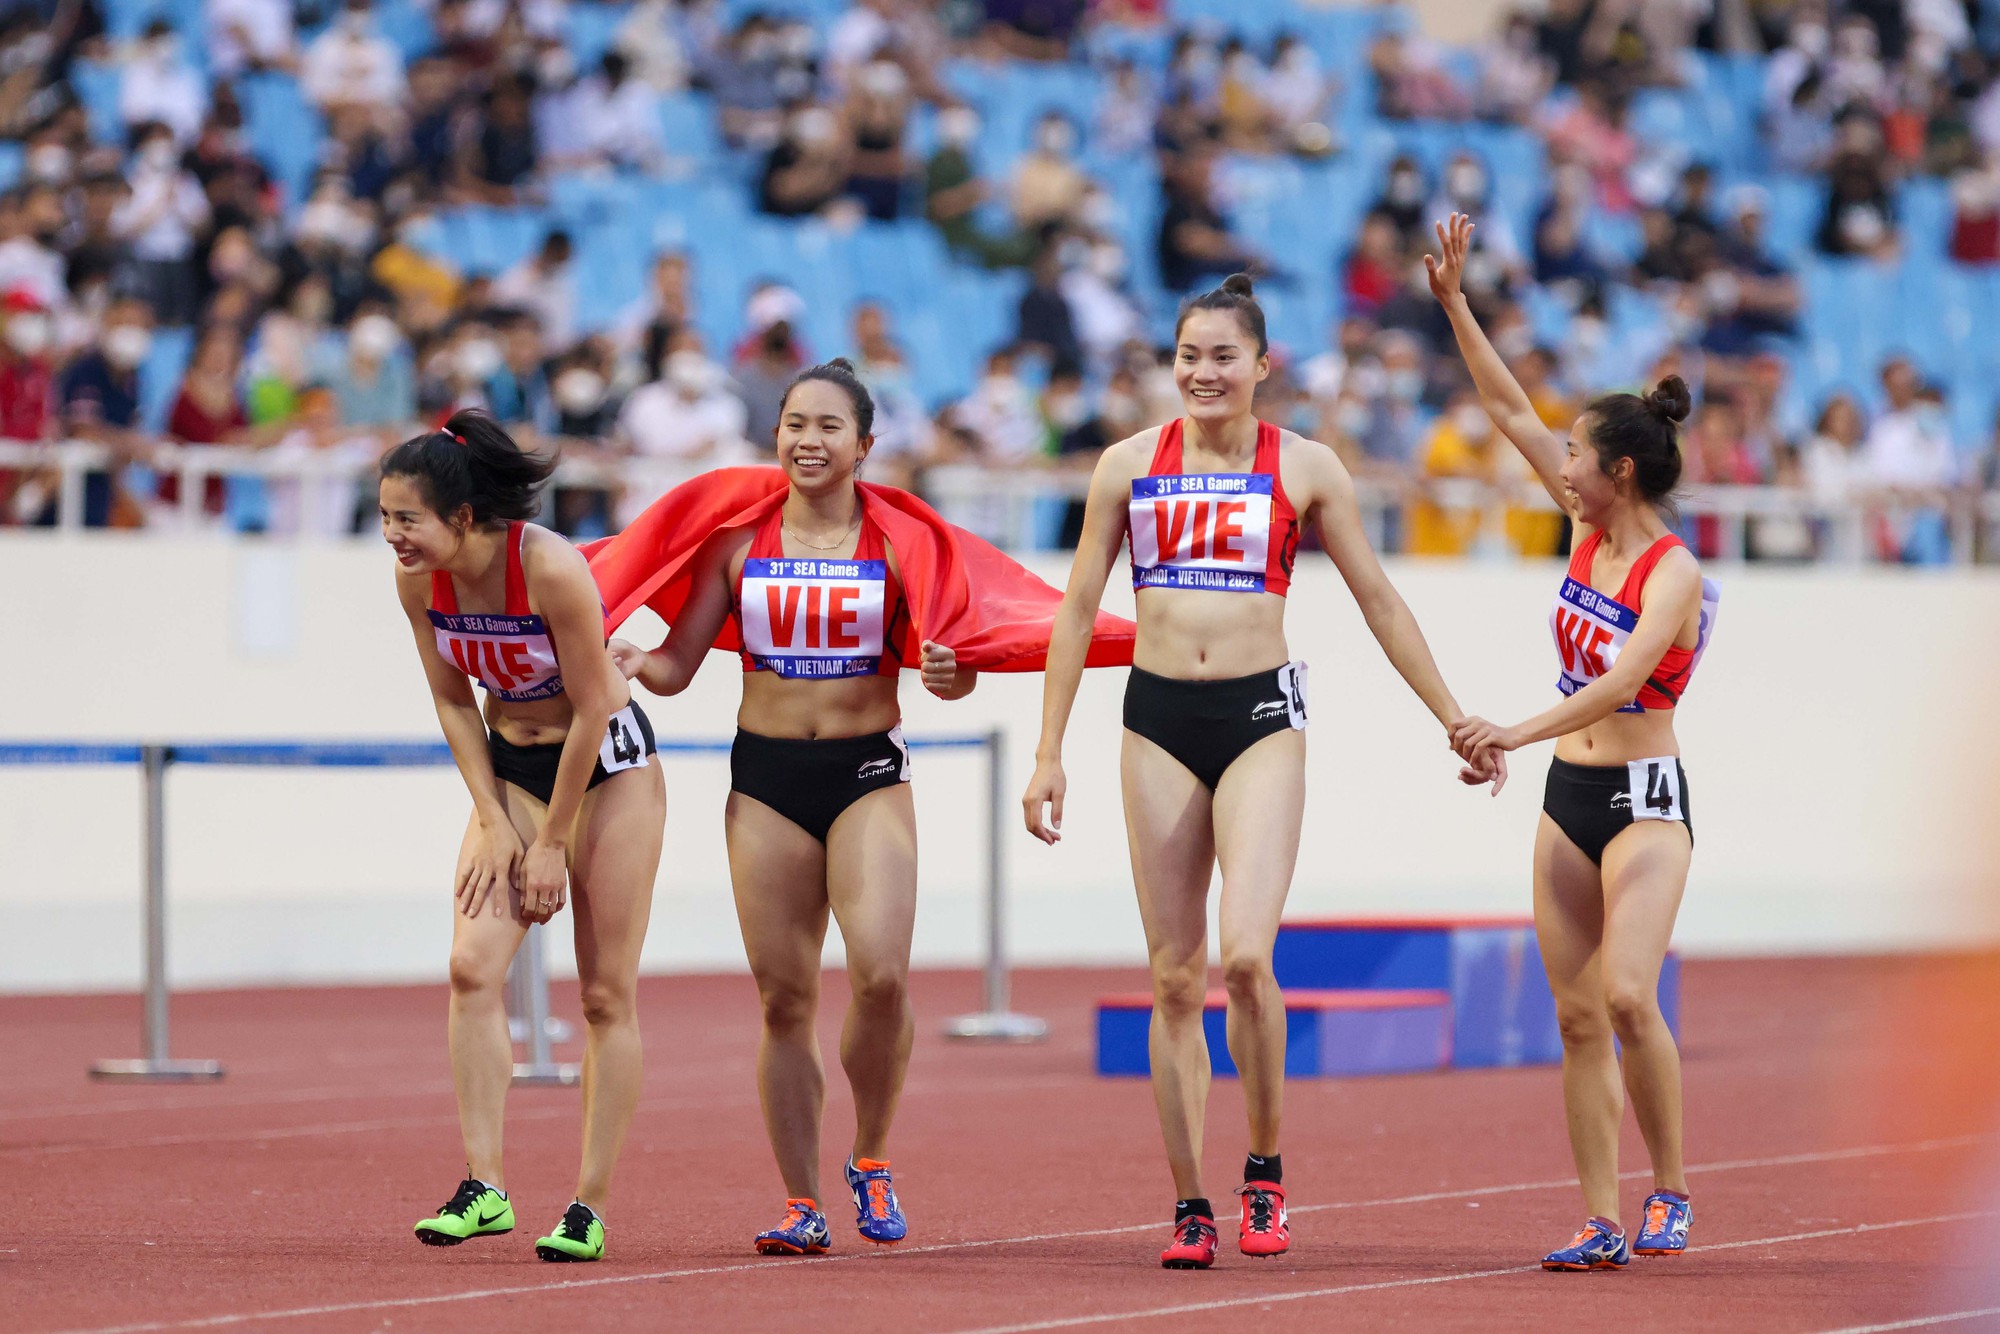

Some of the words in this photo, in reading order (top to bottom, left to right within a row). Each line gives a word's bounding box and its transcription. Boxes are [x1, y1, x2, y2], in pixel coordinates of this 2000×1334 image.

[1181, 477, 1204, 491] SEA
[1207, 476, 1248, 492] Games
[1154, 500, 1247, 563] VIE
[793, 562, 816, 576] SEA
[820, 562, 859, 577] Games
[1178, 570, 1225, 587] VIETNAM
[1228, 573, 1255, 588] 2022
[766, 585, 860, 649] VIE
[1579, 589, 1598, 609] SEA
[1595, 598, 1621, 622] Games
[463, 616, 484, 631] SEA
[485, 617, 520, 632] Games
[449, 638, 535, 691] VIE
[795, 659, 842, 674] VIETNAM
[846, 659, 870, 674] 2022
[609, 717, 641, 764] 4
[858, 764, 896, 779] LI-NING
[1645, 763, 1673, 816] 4
